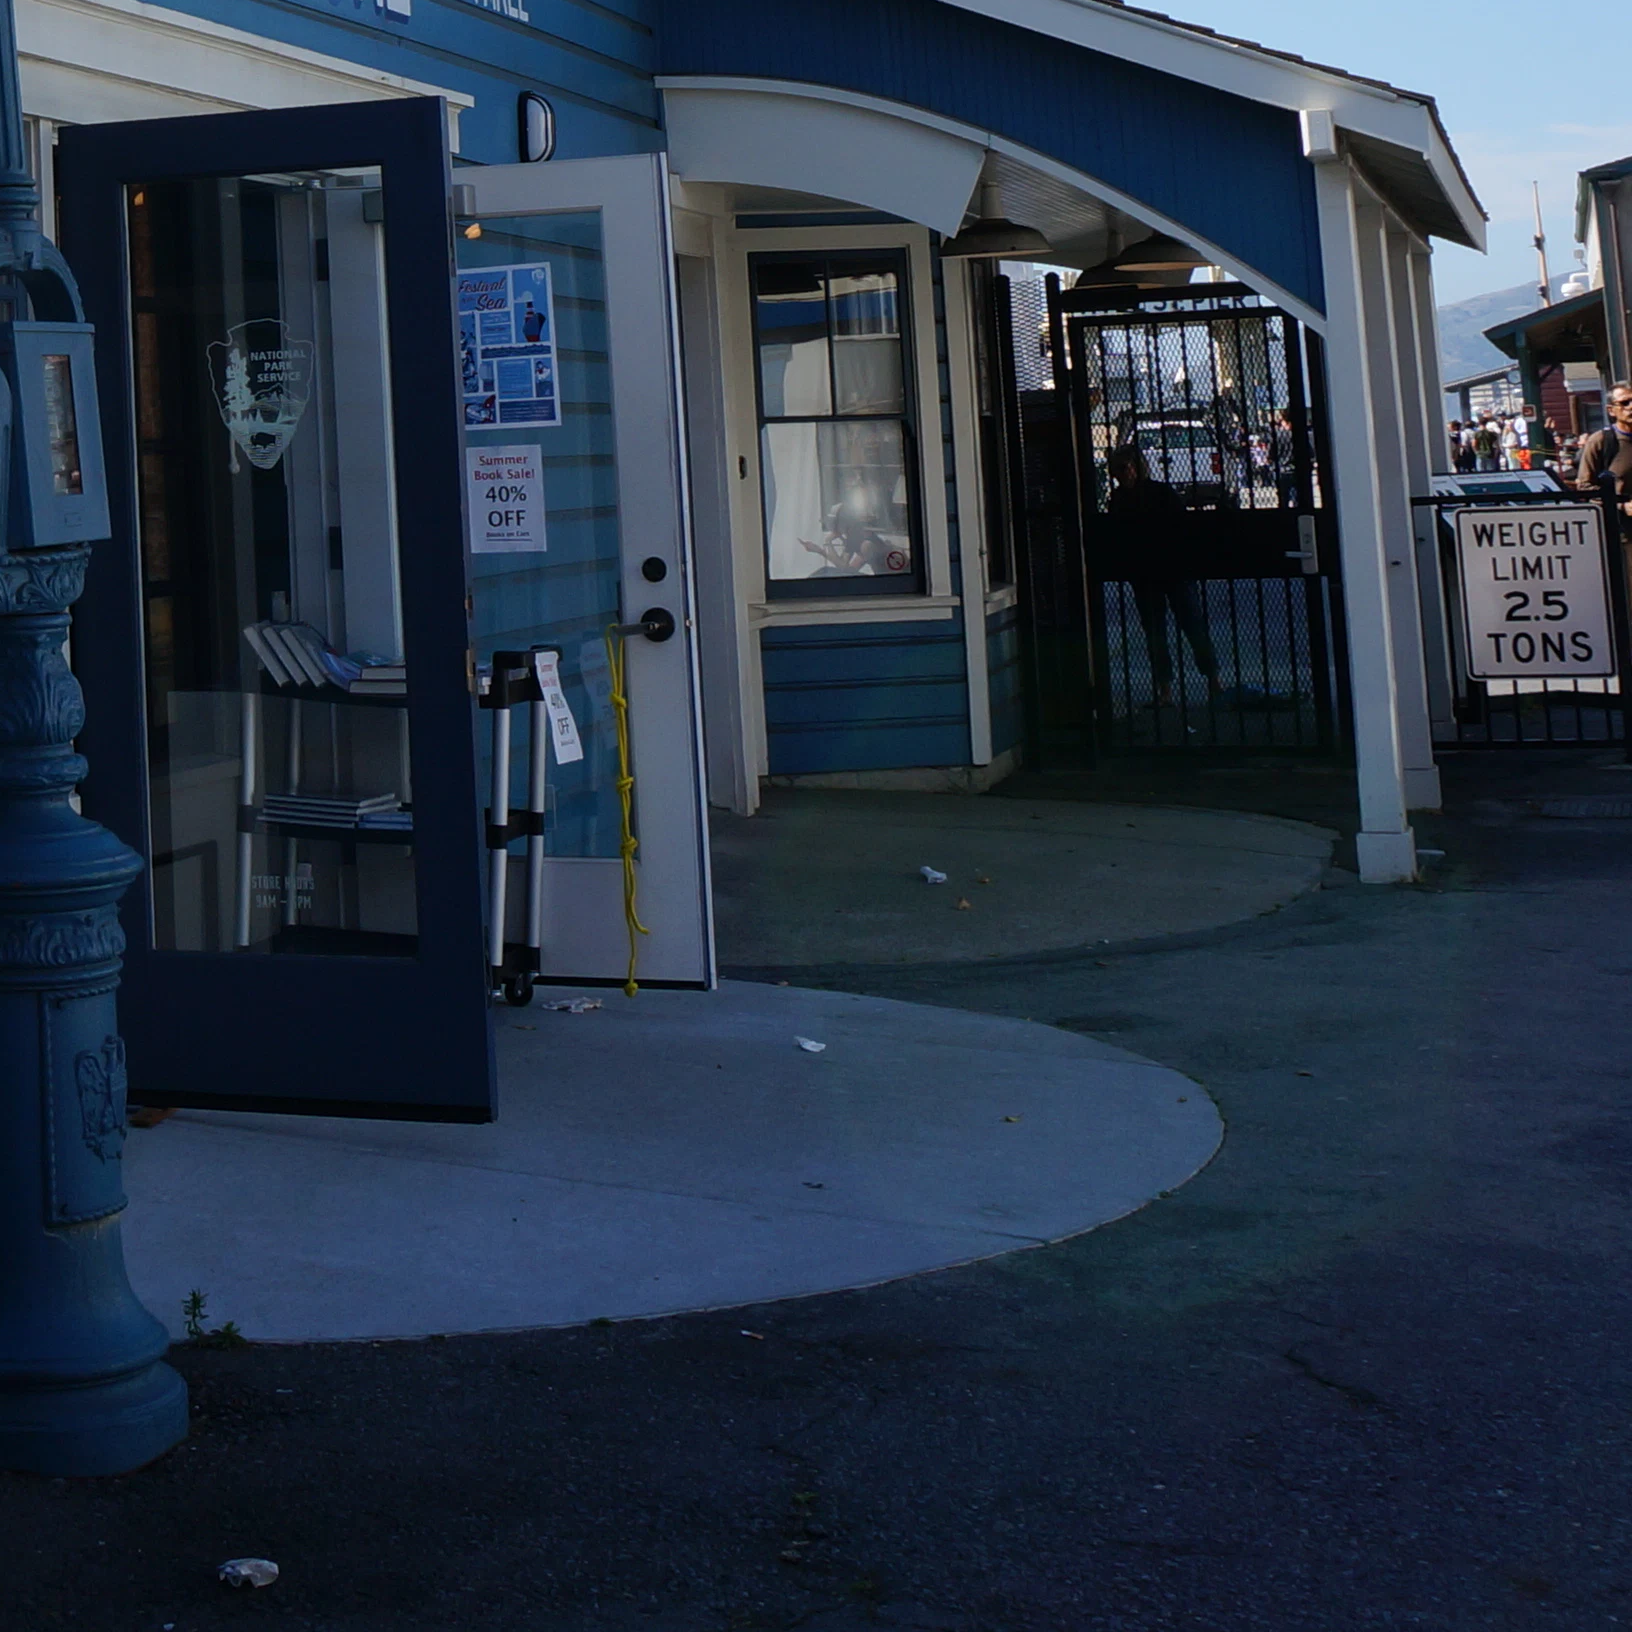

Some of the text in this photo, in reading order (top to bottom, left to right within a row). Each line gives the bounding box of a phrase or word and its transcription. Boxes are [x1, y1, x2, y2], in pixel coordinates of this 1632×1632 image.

[475, 293, 506, 311] Sea
[250, 348, 306, 362] NATIONAL
[264, 361, 293, 371] PARK
[257, 371, 302, 383] SERVICE
[479, 455, 528, 466] Summer
[474, 468, 535, 480] Book Sale!
[485, 485, 527, 503] 40%
[488, 510, 526, 527] OFF
[1472, 520, 1589, 548] WEIGHT
[1491, 555, 1572, 582] LIMIT
[1504, 590, 1569, 623] 2.5
[1487, 631, 1593, 664] TONS
[251, 875, 281, 889] STORE
